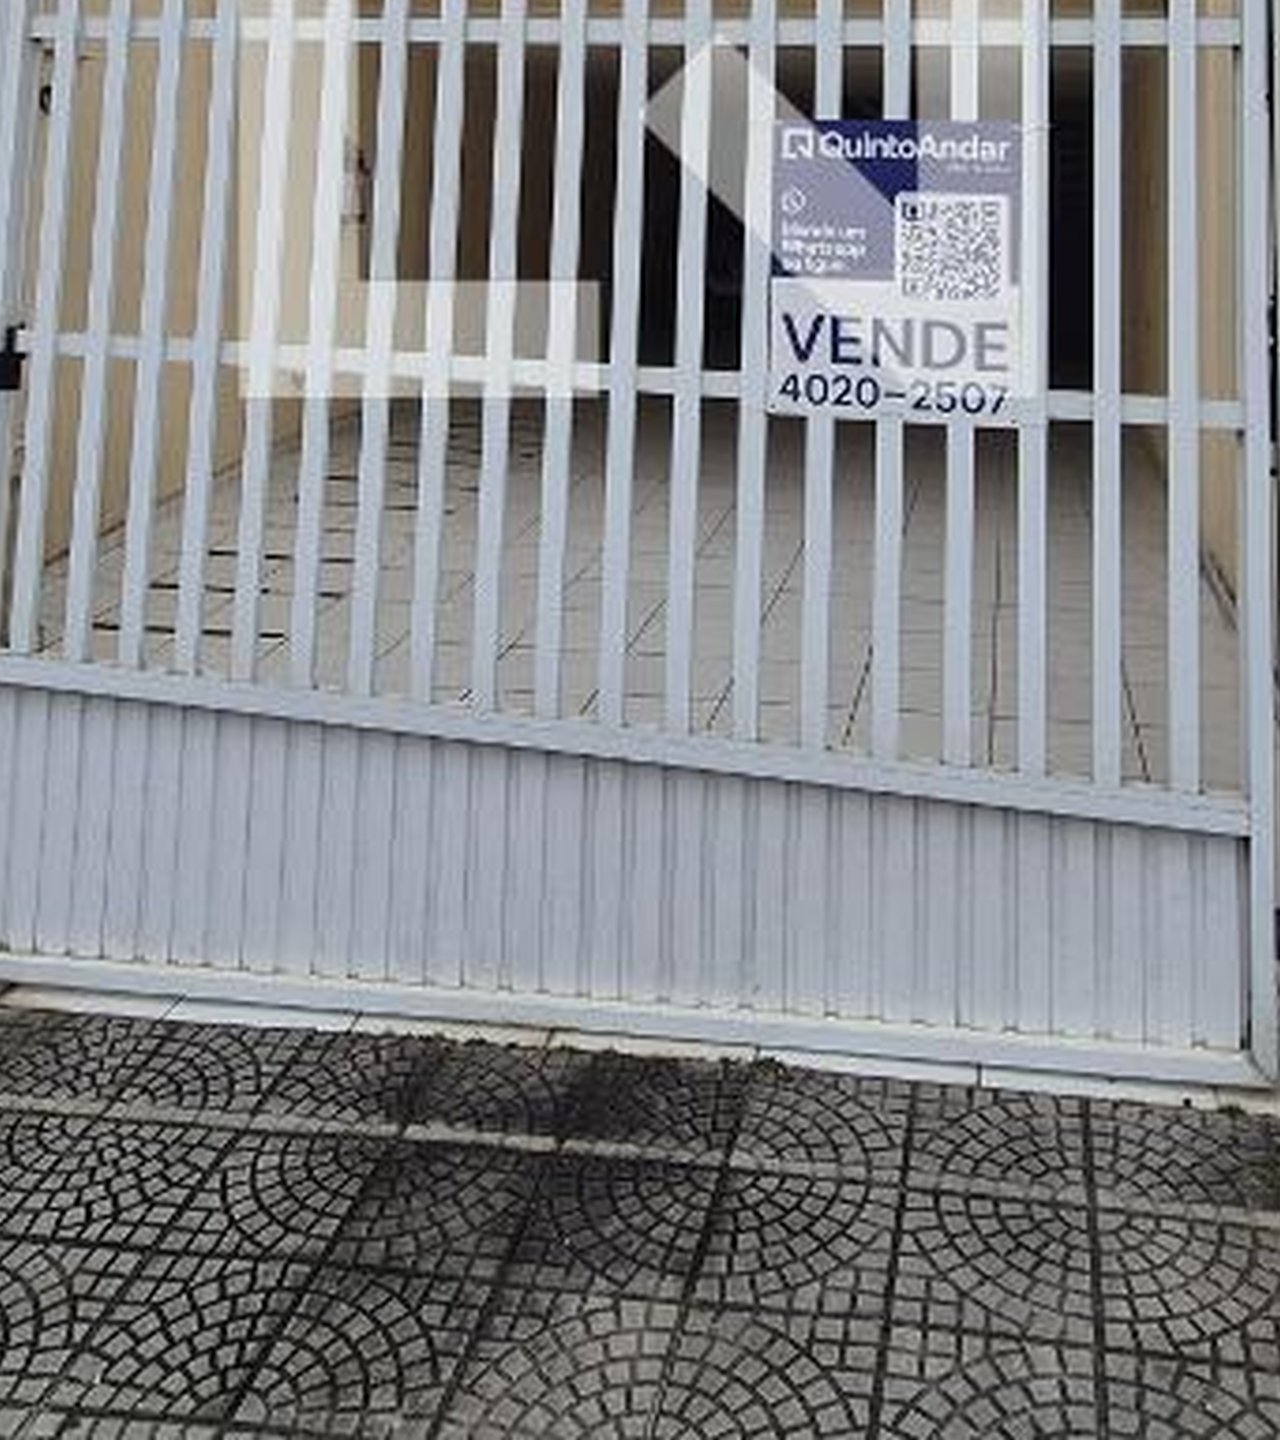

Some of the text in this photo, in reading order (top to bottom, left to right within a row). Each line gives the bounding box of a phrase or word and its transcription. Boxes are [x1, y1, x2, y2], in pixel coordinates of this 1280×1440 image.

[821, 130, 1011, 162] QuintoAndar
[781, 313, 1009, 372] VENDE
[778, 373, 1010, 415] 4020-2507
